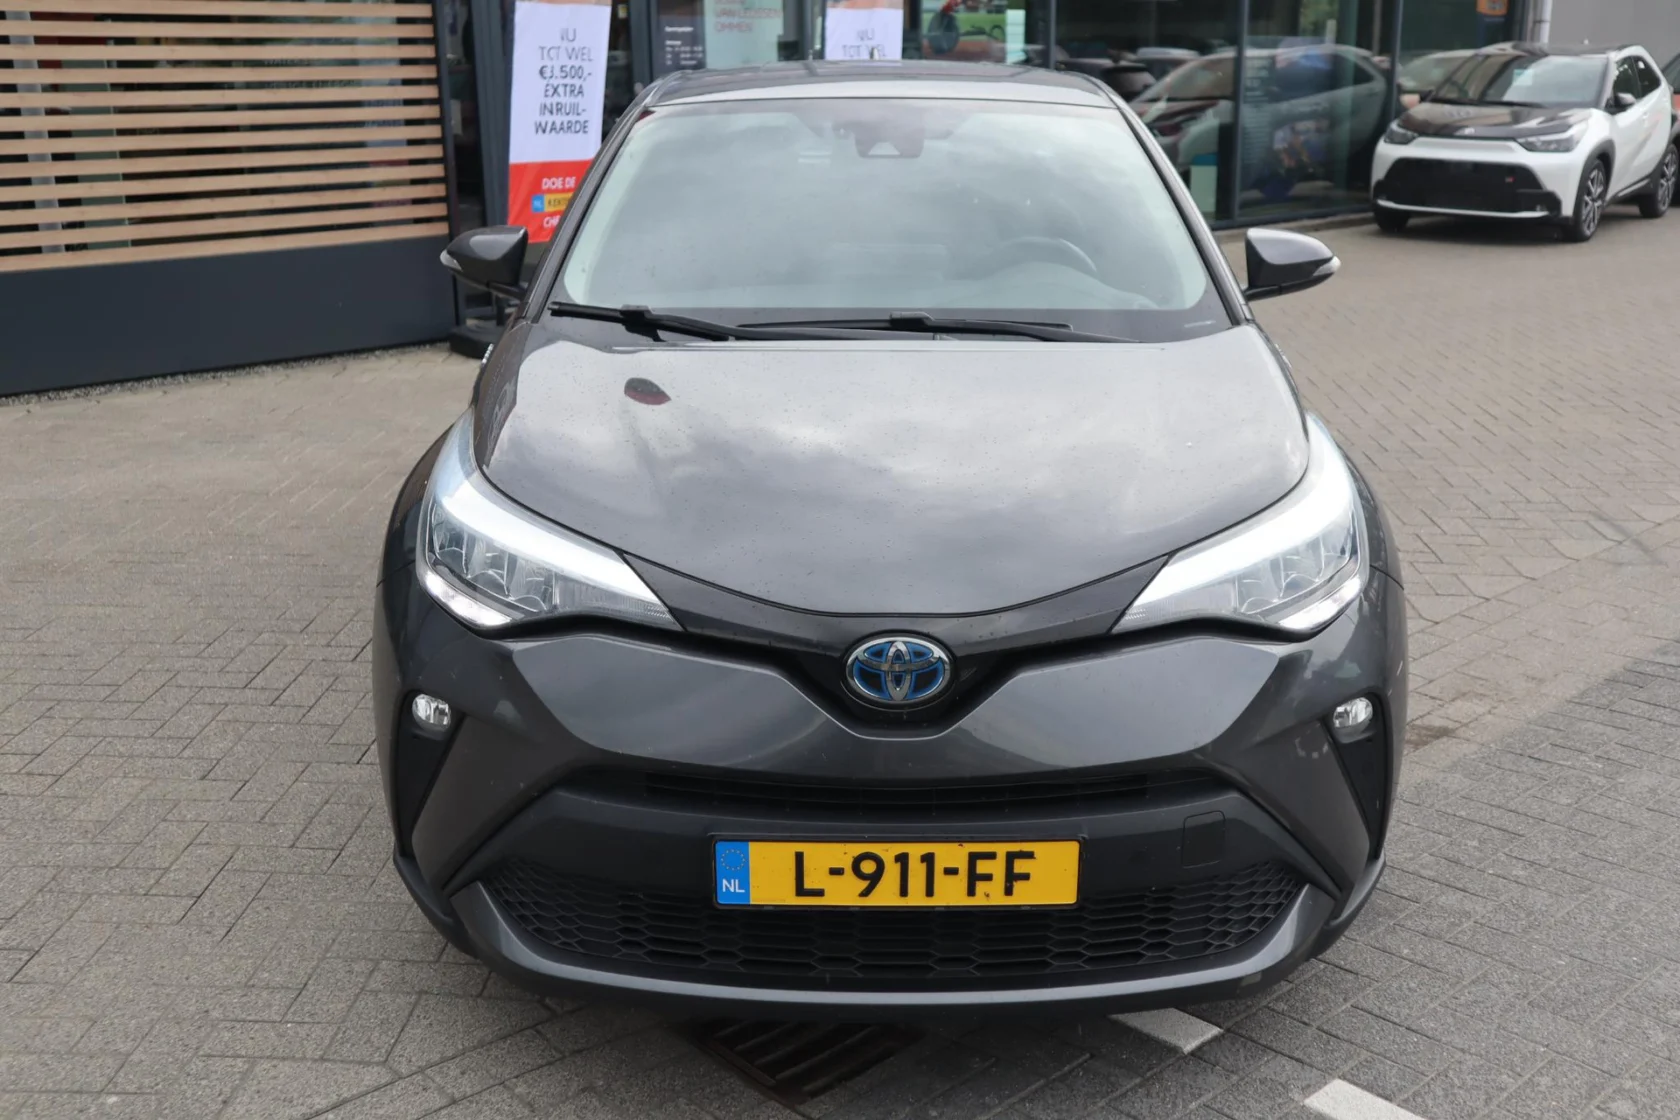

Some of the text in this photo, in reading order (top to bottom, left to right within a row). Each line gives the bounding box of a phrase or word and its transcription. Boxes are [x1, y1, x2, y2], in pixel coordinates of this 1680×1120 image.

[565, 46, 594, 62] WEL
[544, 84, 584, 98] EXTRA
[539, 102, 587, 117] INRUIL-
[534, 119, 589, 135] WAARDE
[722, 850, 1035, 898] NL L-911-FF
